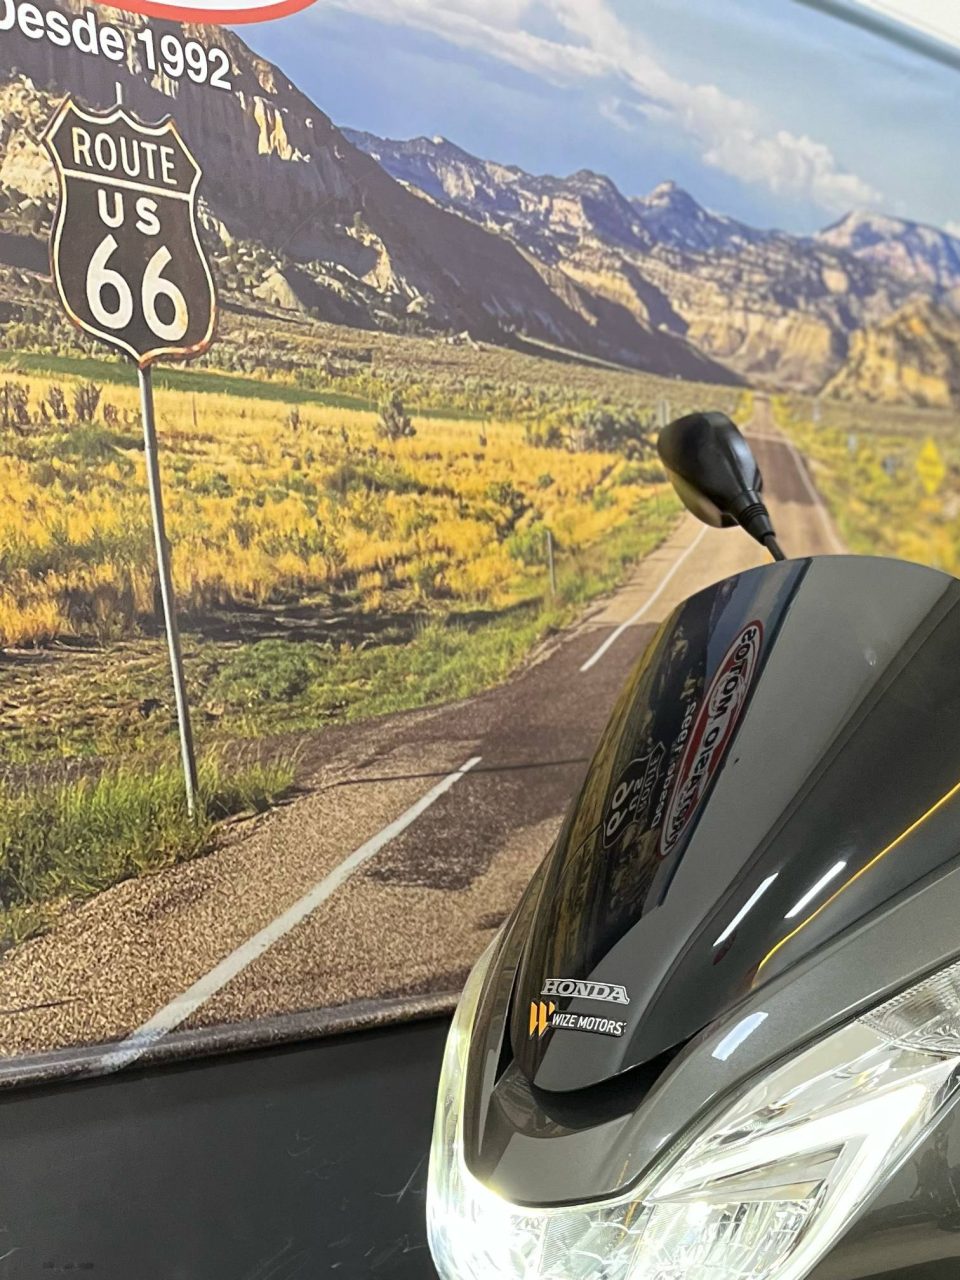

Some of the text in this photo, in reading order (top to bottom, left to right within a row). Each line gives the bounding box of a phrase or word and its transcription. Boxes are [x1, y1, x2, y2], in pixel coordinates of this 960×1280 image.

[138, 28, 232, 91] 1992
[72, 126, 178, 185] ROUTE
[98, 189, 161, 236] US
[86, 234, 190, 342] 66
[541, 979, 630, 1005] HONDA
[552, 1013, 622, 1035] WIZE MOTORS
